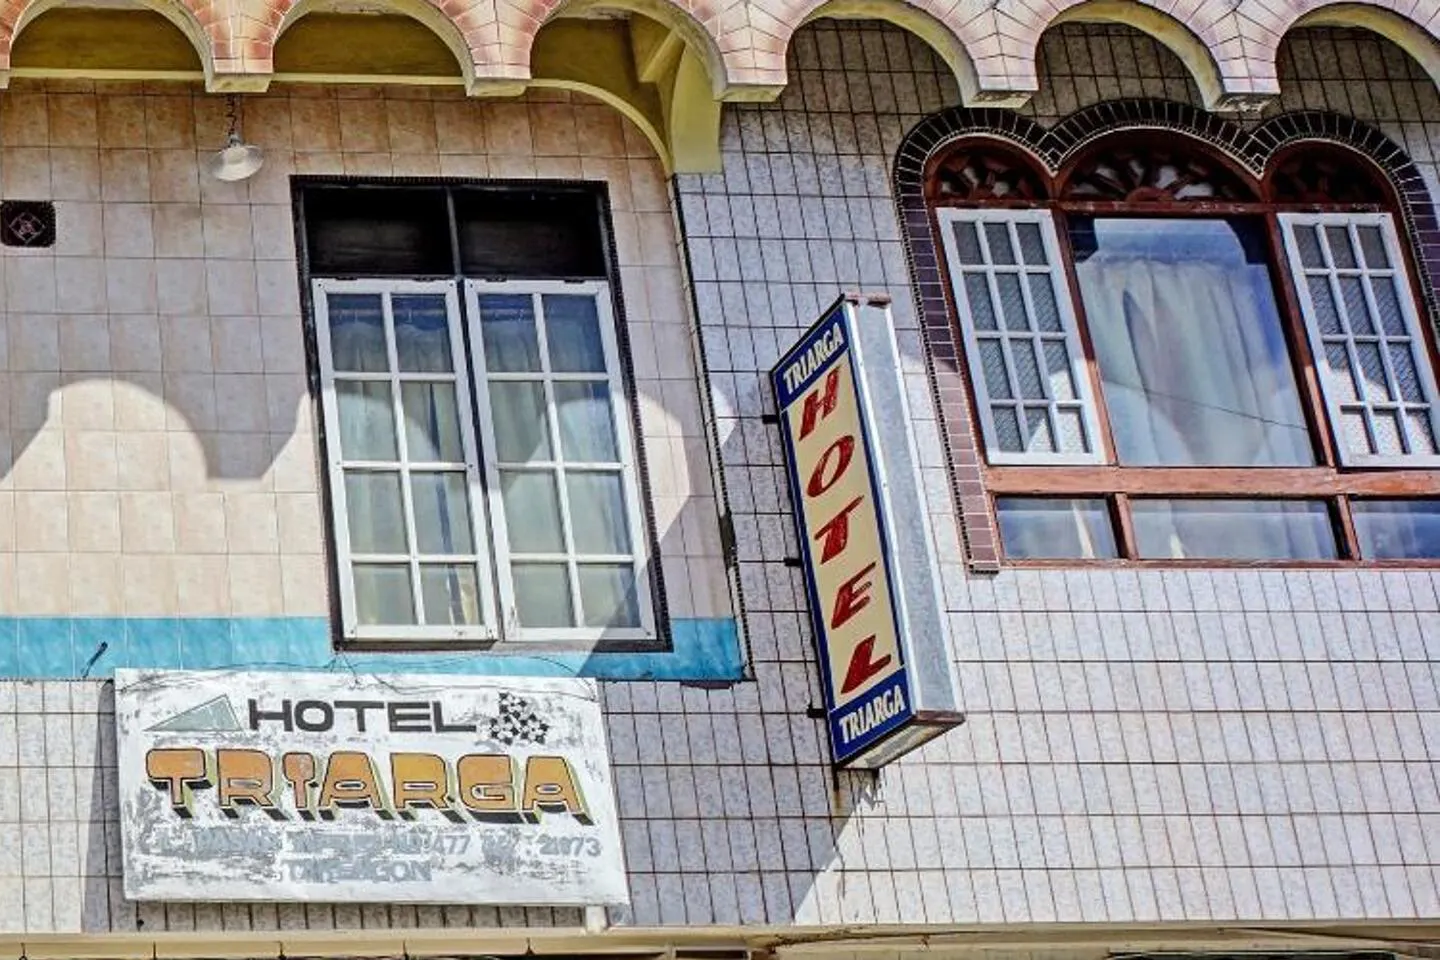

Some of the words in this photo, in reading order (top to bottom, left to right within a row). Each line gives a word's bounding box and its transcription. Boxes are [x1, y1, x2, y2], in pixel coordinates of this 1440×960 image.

[782, 322, 844, 395] TRIARGA
[798, 366, 892, 695] HOTEL
[248, 698, 477, 733] HOTEL
[838, 684, 906, 744] TRIARGA
[146, 748, 594, 826] TRIARGA
